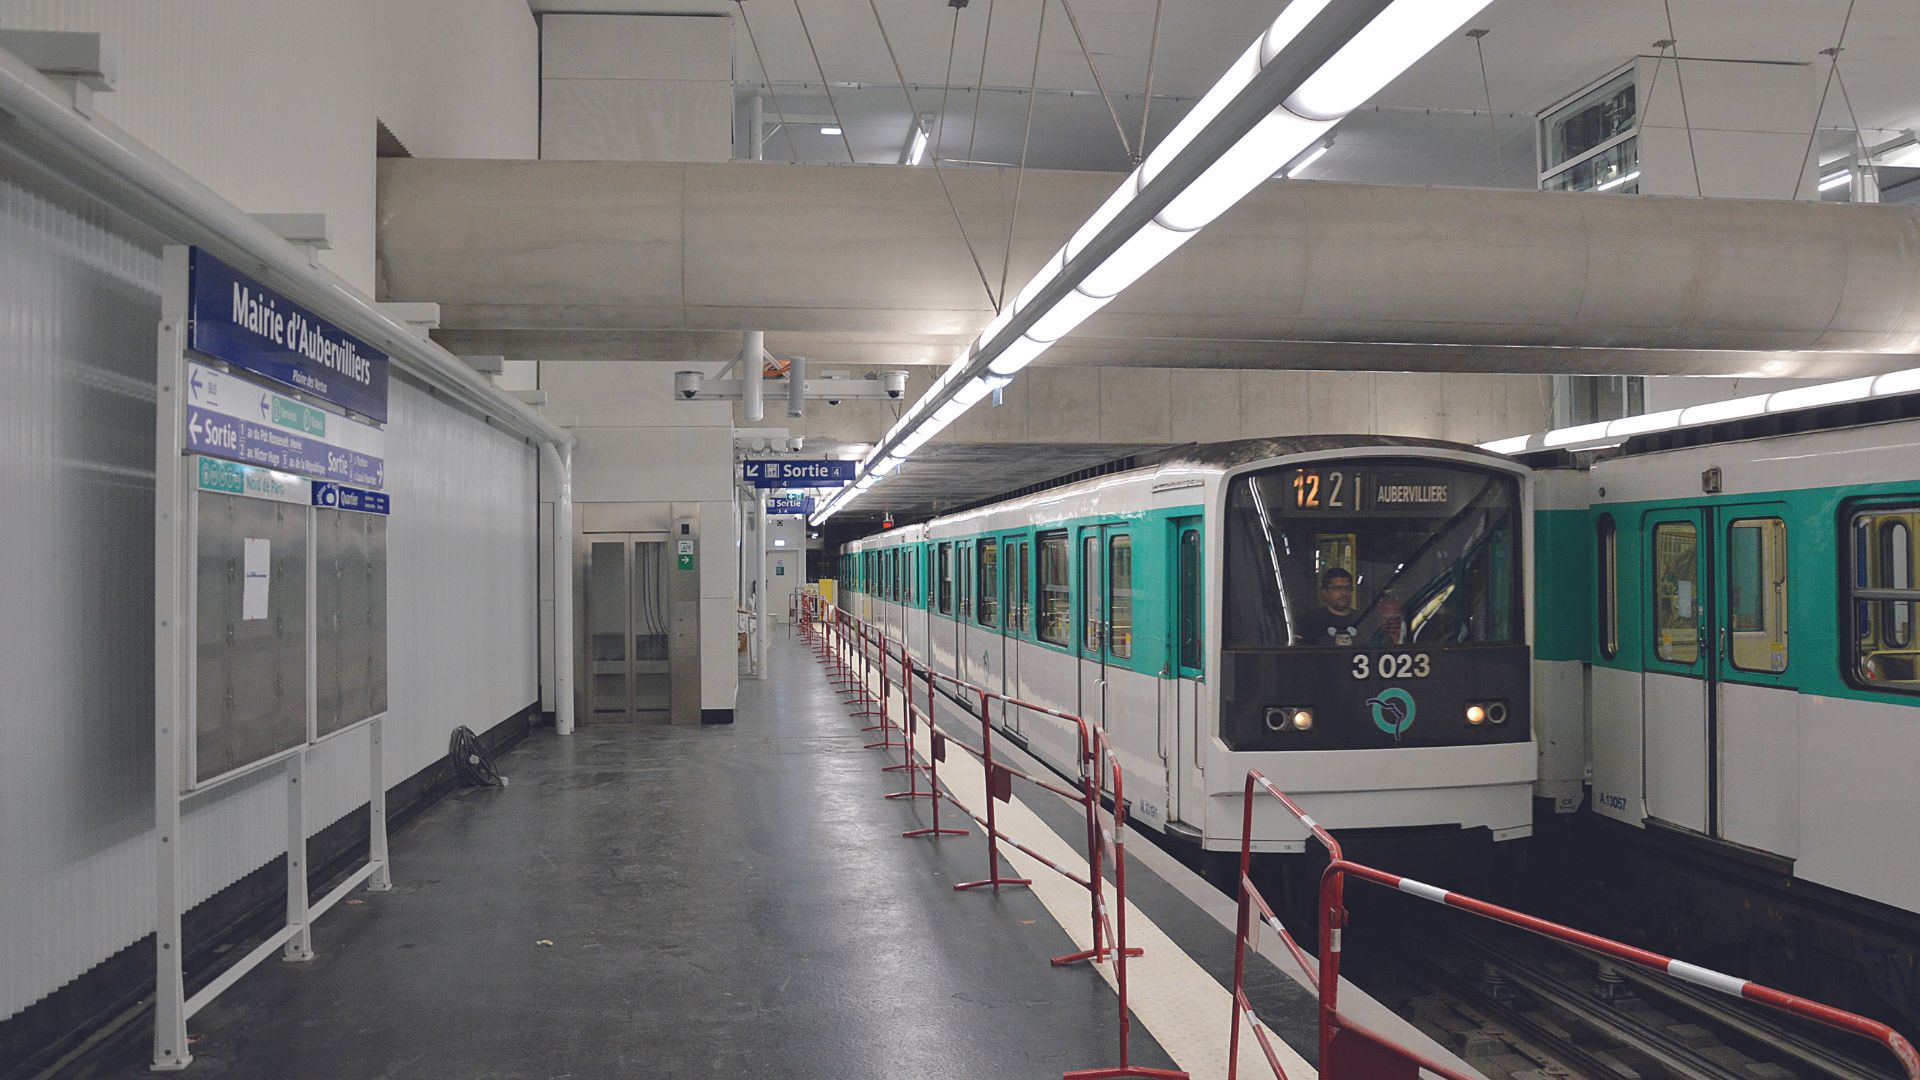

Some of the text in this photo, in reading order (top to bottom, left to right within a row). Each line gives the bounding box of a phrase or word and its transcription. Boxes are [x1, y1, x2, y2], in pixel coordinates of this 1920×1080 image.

[232, 281, 371, 386] Mairie d'Aubervilliers
[292, 369, 307, 386] Plaine
[204, 418, 237, 450] Sortie
[327, 451, 348, 475] Sortie
[783, 463, 840, 478] Sortie 4
[1293, 468, 1320, 508] 12
[1377, 485, 1448, 503] AUBERVILLIERS
[776, 499, 801, 508] Sortie
